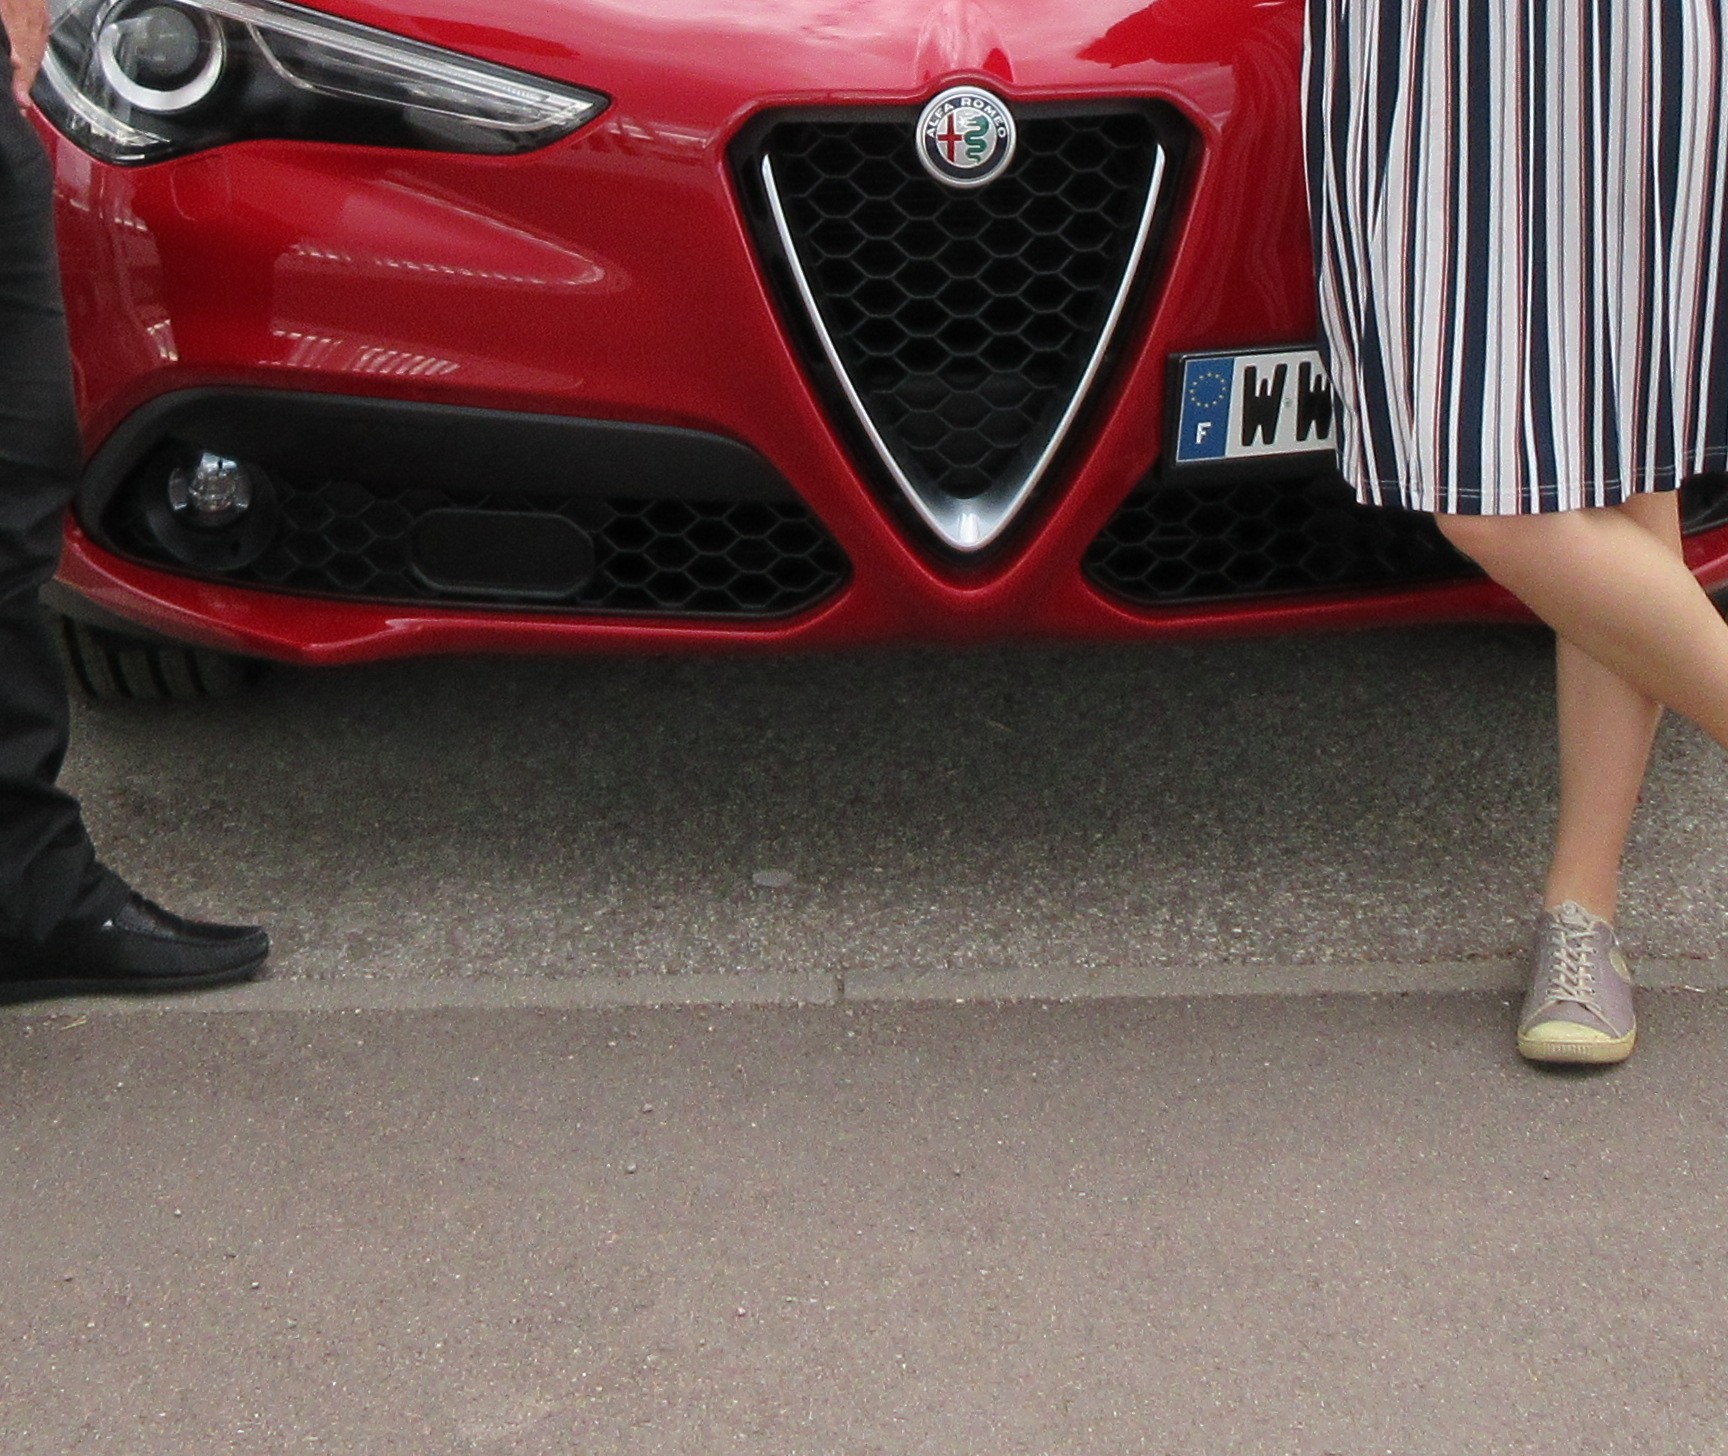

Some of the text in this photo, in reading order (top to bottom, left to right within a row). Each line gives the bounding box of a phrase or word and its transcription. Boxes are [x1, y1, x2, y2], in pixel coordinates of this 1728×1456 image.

[928, 97, 1006, 138] ALFA ROMEO
[1196, 421, 1212, 444] F
